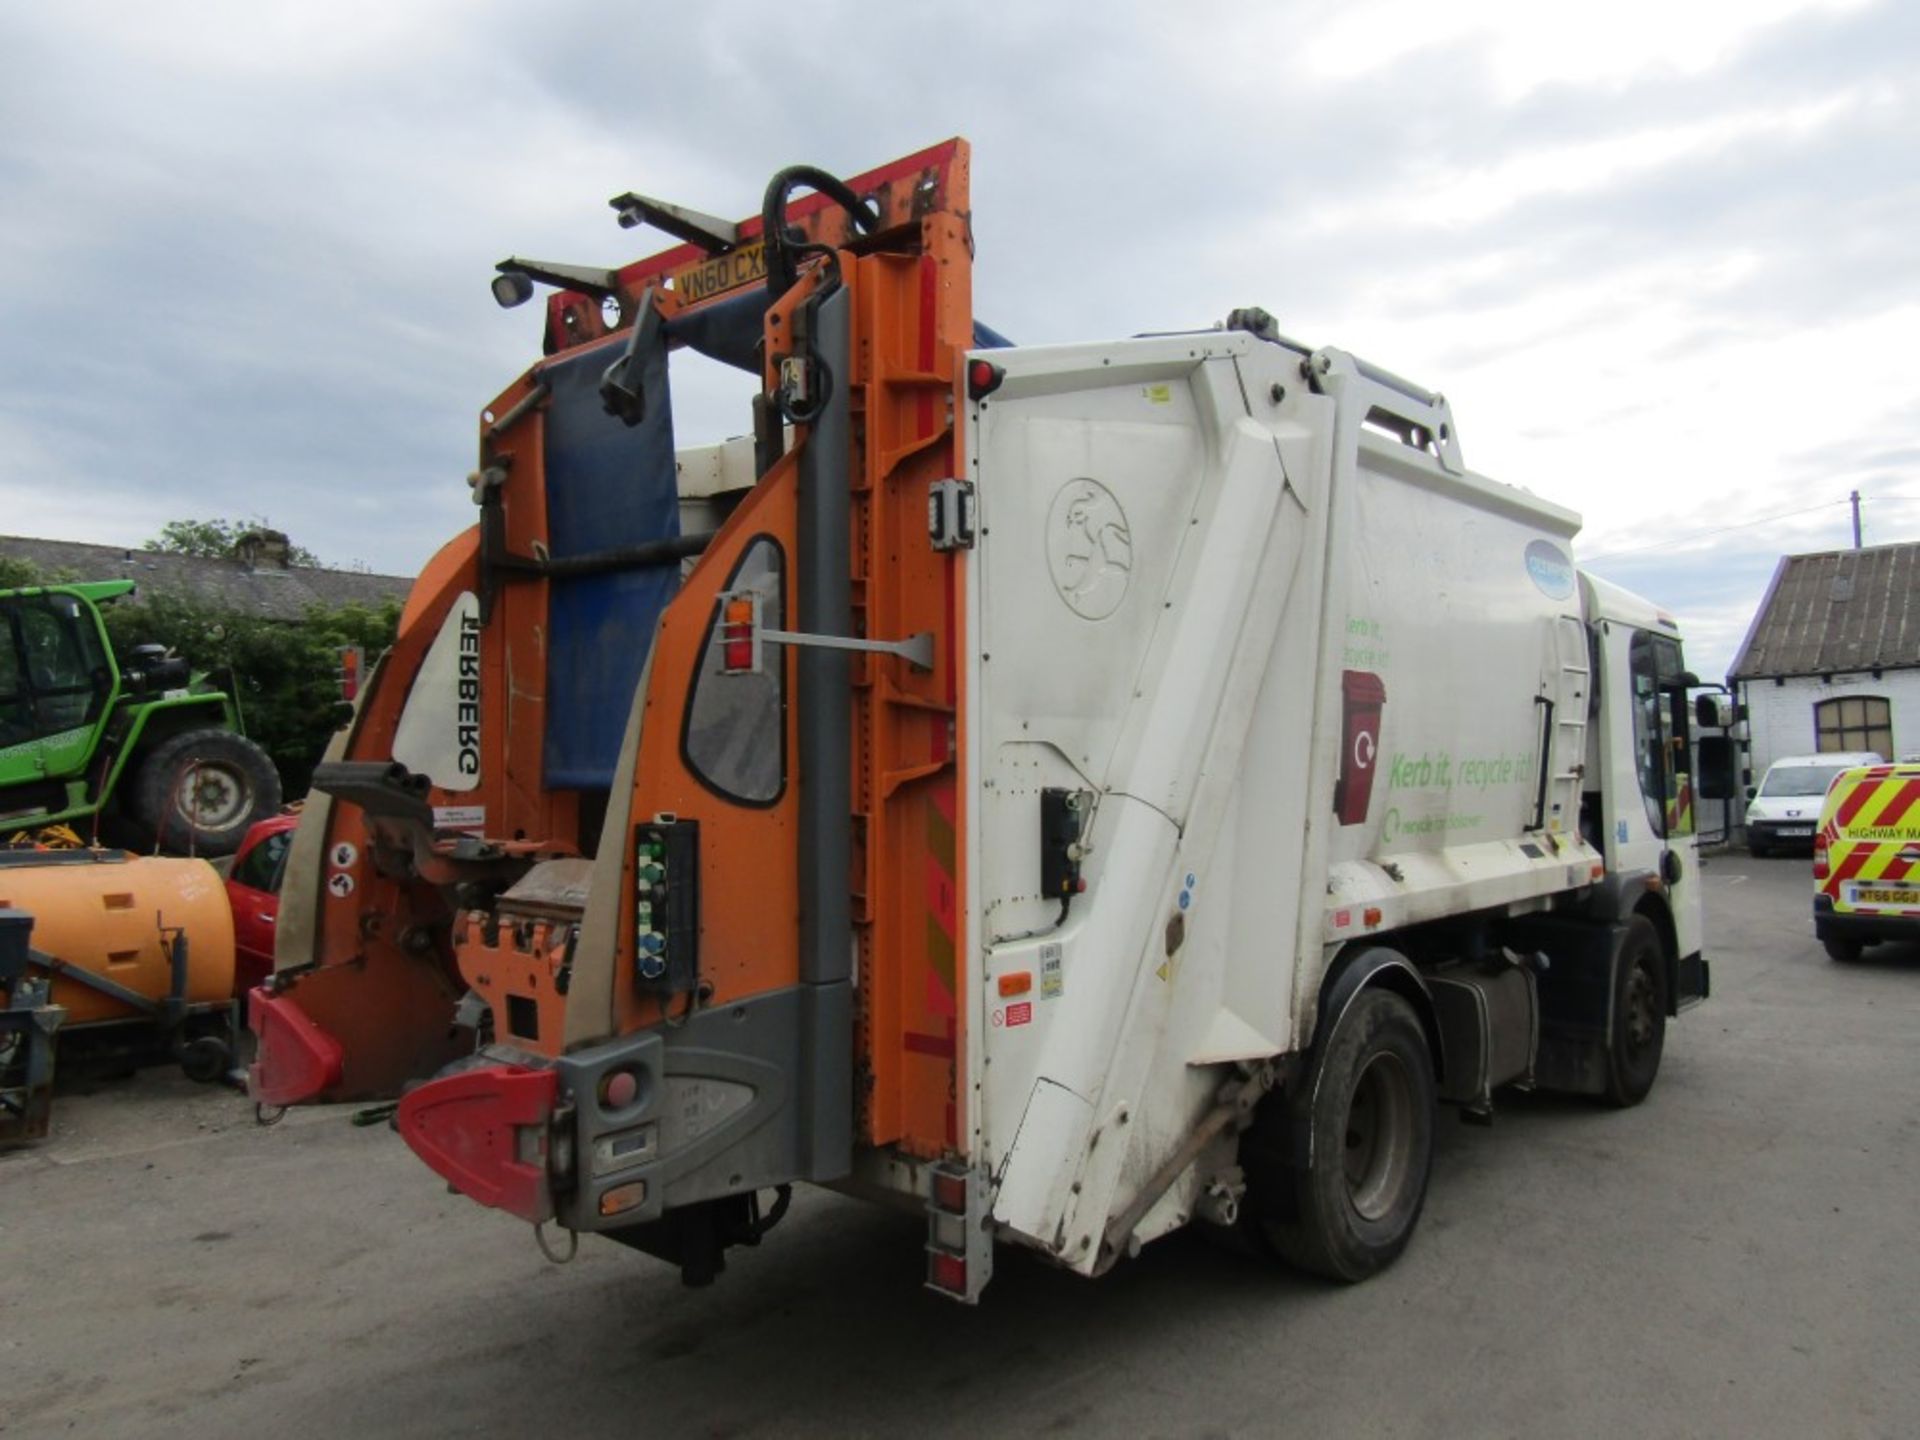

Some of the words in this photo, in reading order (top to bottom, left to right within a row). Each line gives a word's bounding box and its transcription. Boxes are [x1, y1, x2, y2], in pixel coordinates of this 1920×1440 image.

[1389, 752, 1431, 788] Kerb
[1434, 751, 1452, 794] it,
[1457, 752, 1512, 792] recycle
[1848, 827, 1902, 839] HIGHWAY
